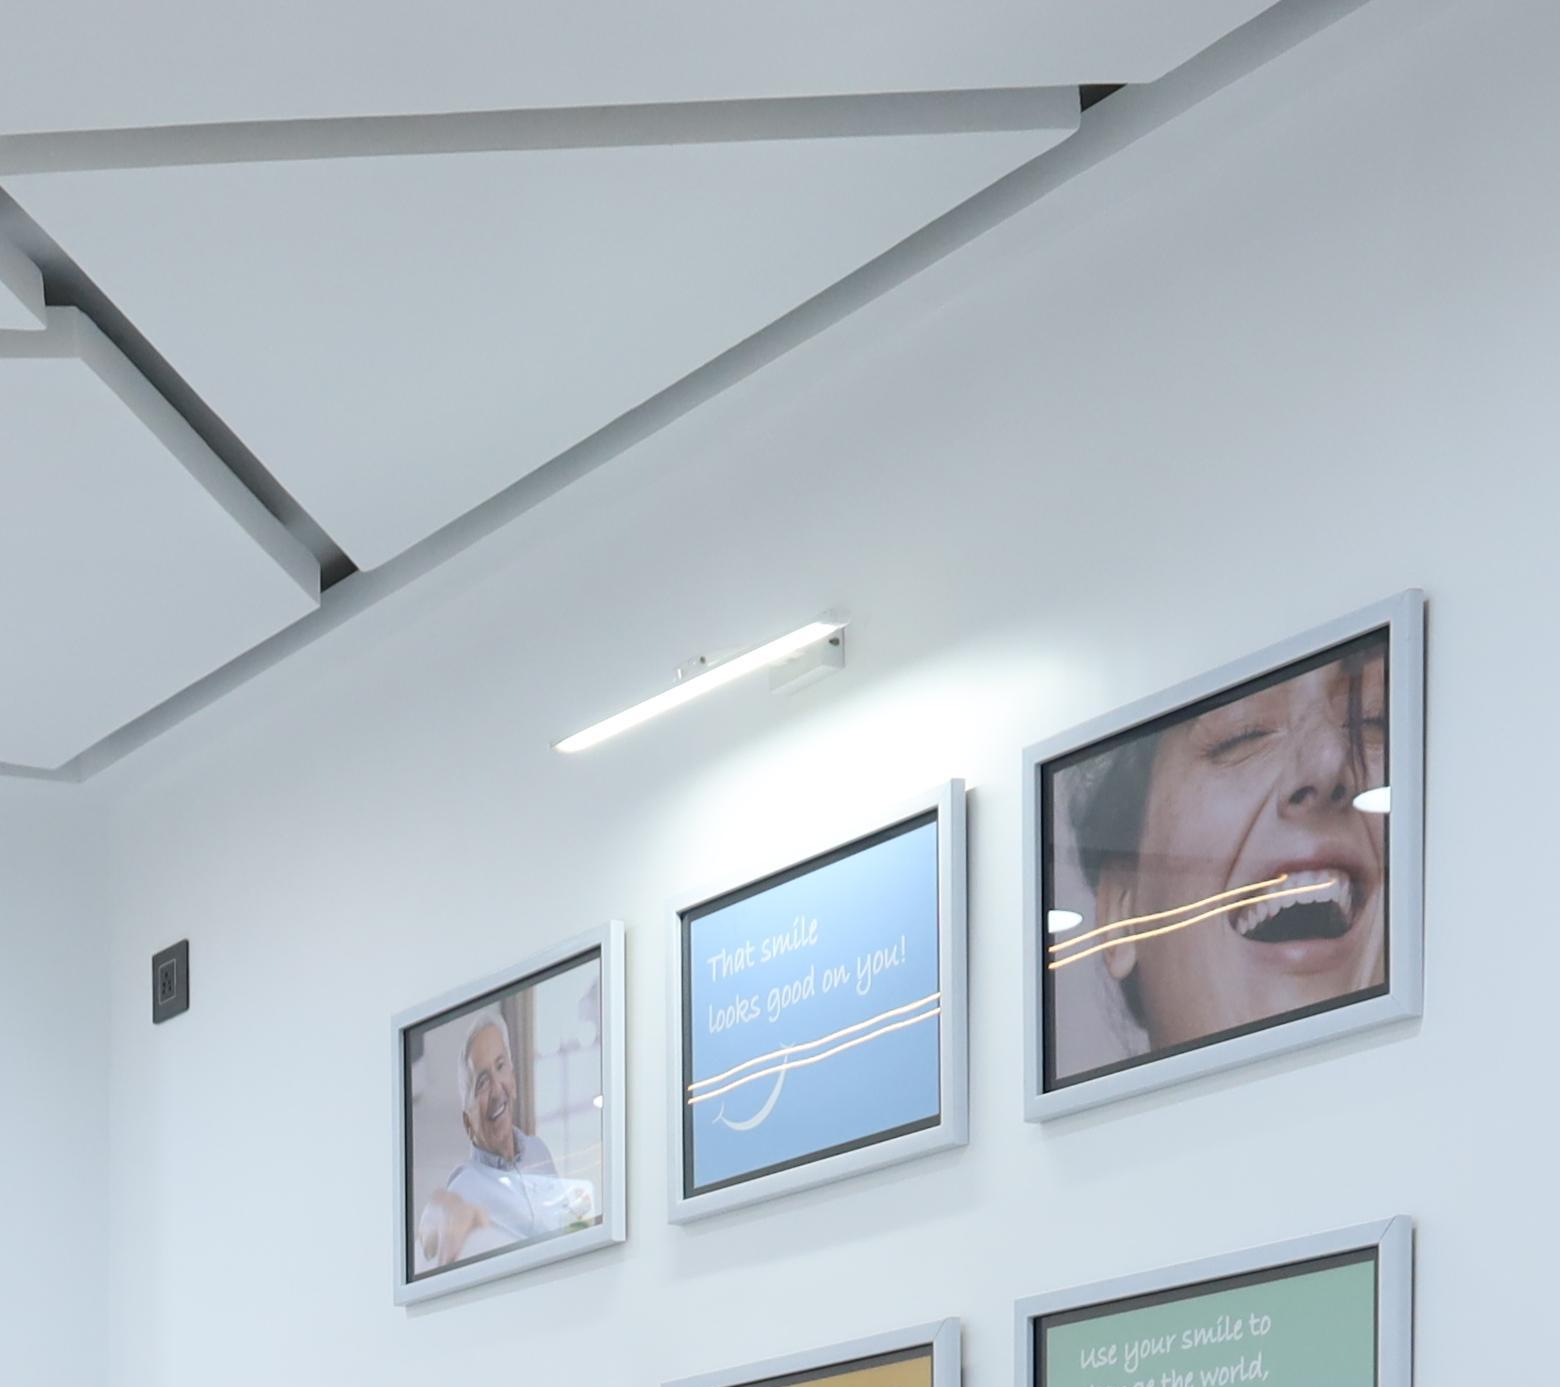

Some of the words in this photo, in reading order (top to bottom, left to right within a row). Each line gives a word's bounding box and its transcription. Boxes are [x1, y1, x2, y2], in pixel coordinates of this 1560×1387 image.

[707, 941, 755, 982] That
[760, 915, 819, 962] smile
[708, 990, 761, 1034] looks
[766, 964, 815, 1022] good
[822, 964, 850, 992] on
[856, 936, 906, 995] you!
[1080, 1344, 1118, 1369] Use
[1123, 1334, 1176, 1373] your
[1181, 1315, 1243, 1350] smile
[1248, 1312, 1272, 1336] to
